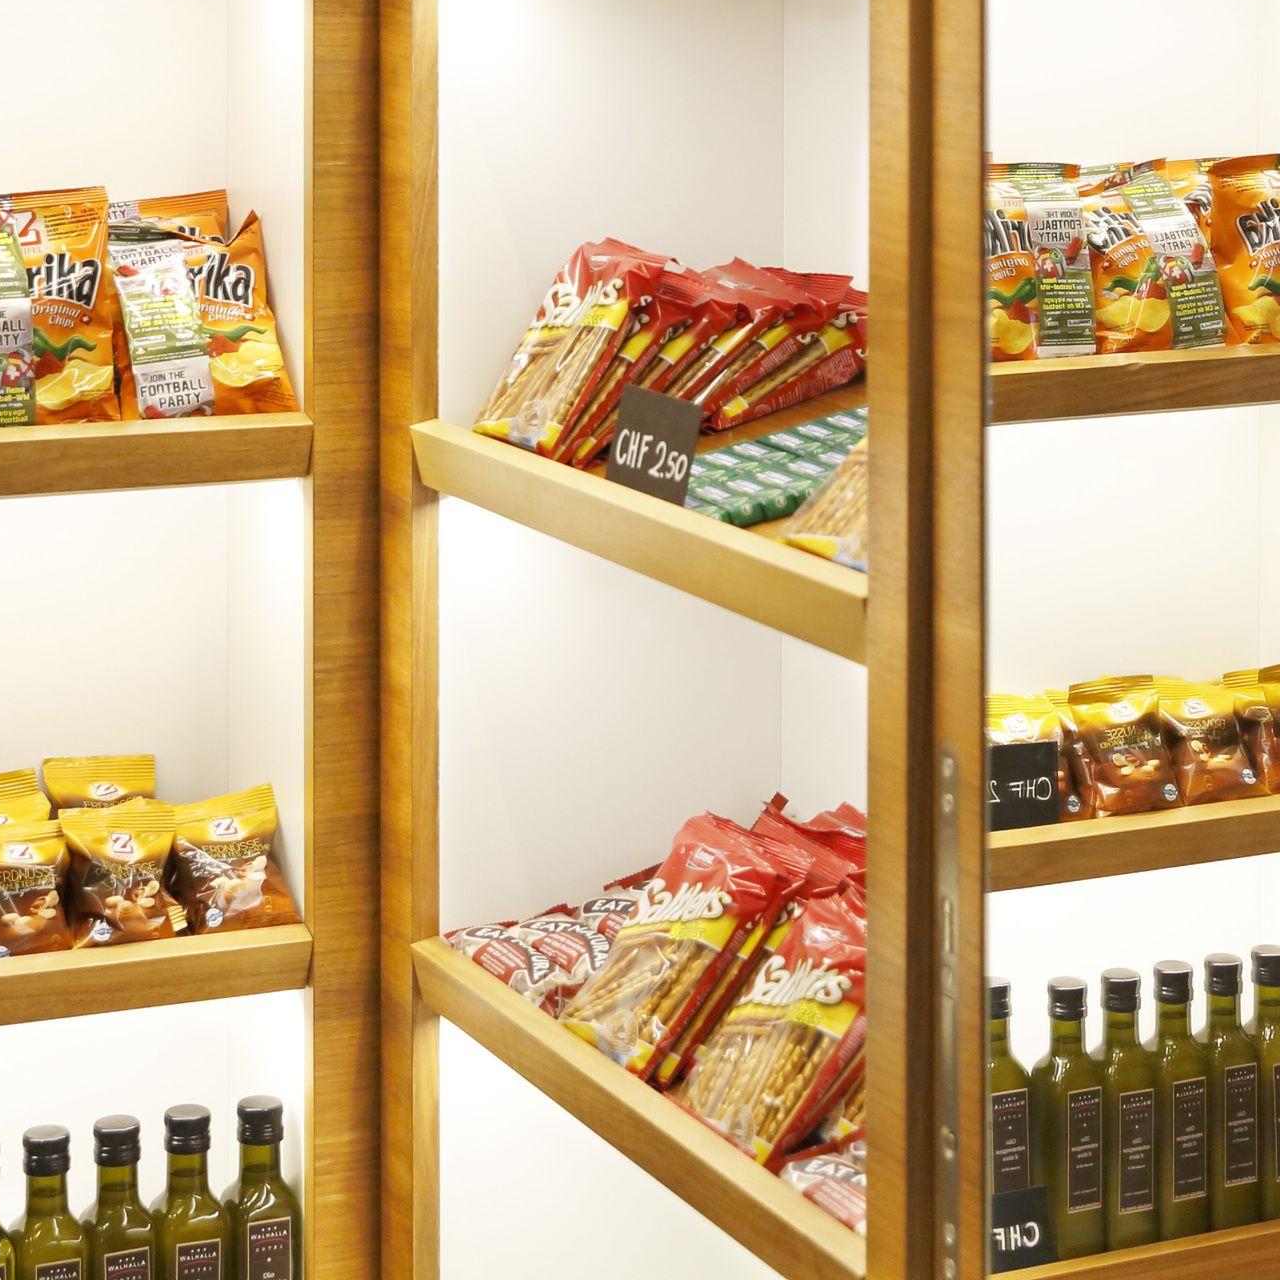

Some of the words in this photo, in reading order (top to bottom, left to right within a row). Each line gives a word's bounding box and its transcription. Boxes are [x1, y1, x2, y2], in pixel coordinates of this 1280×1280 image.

[32, 304, 81, 318] Original
[49, 315, 76, 328] Chips
[149, 372, 166, 384] JOIN
[169, 370, 186, 379] THE
[140, 378, 206, 398] FOOTBALL
[159, 393, 203, 409] PARTY
[615, 428, 654, 469] CHF
[648, 440, 688, 482] 2.50
[592, 899, 628, 911] EAT
[475, 927, 510, 939] EAT
[530, 921, 570, 932] EAT
[567, 924, 610, 967] NATURAL
[805, 1159, 855, 1178] EAT
[251, 1230, 288, 1240] WALHALLA
[180, 1251, 217, 1262] WALHALLA
[108, 1260, 146, 1271] WALHALLA
